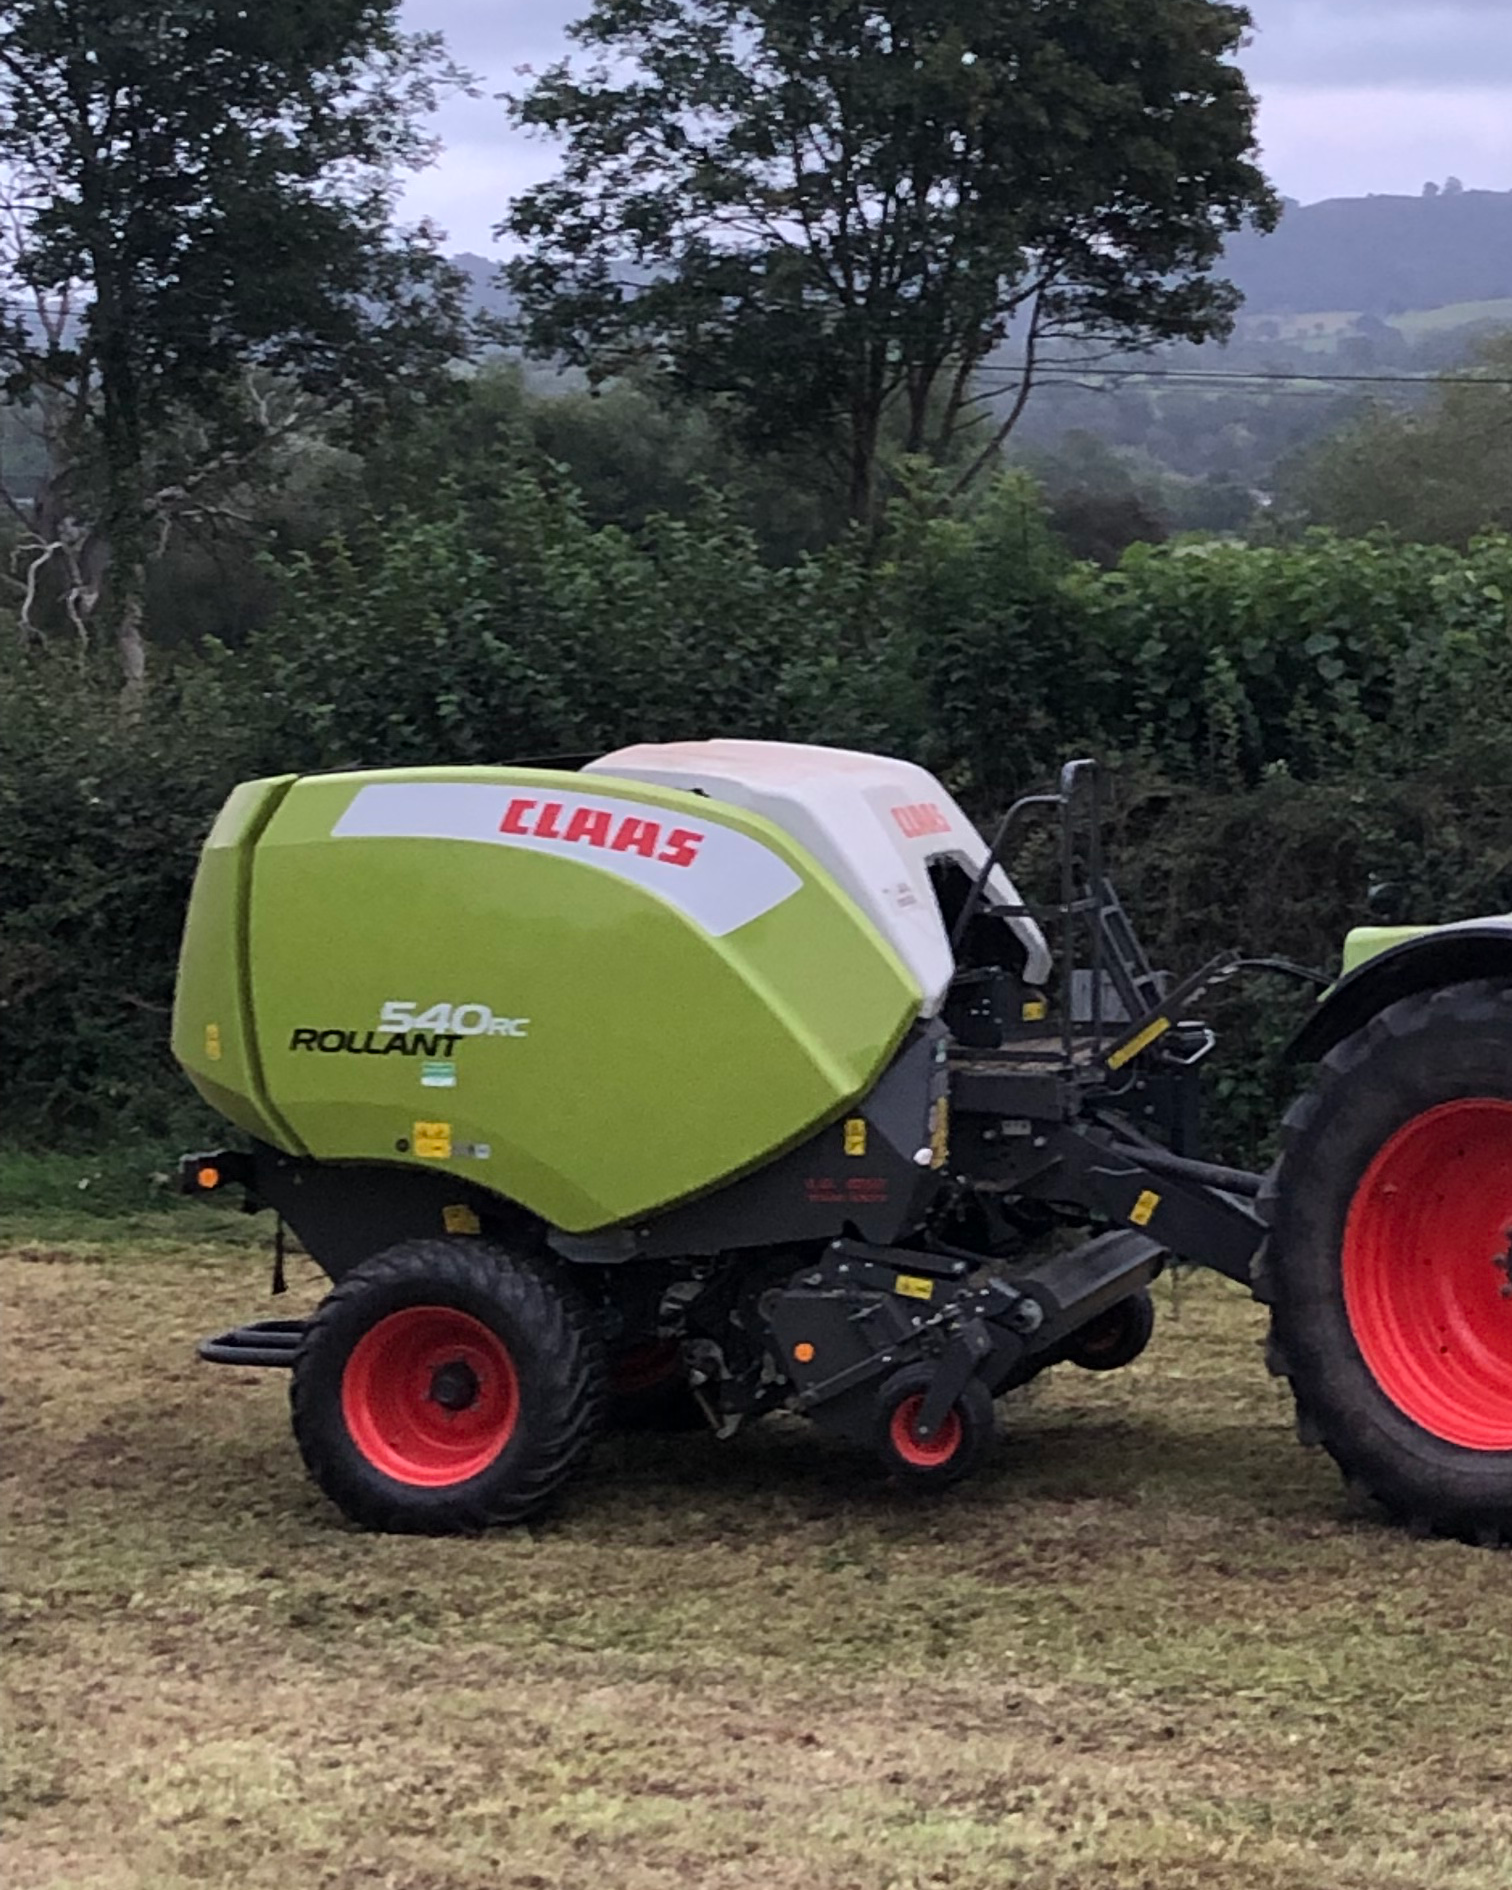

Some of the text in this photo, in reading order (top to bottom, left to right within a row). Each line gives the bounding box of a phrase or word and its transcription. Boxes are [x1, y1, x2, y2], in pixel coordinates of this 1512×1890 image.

[500, 799, 705, 867] CLAAS
[891, 803, 952, 838] CLAAS
[289, 1027, 463, 1057] ROLLANT
